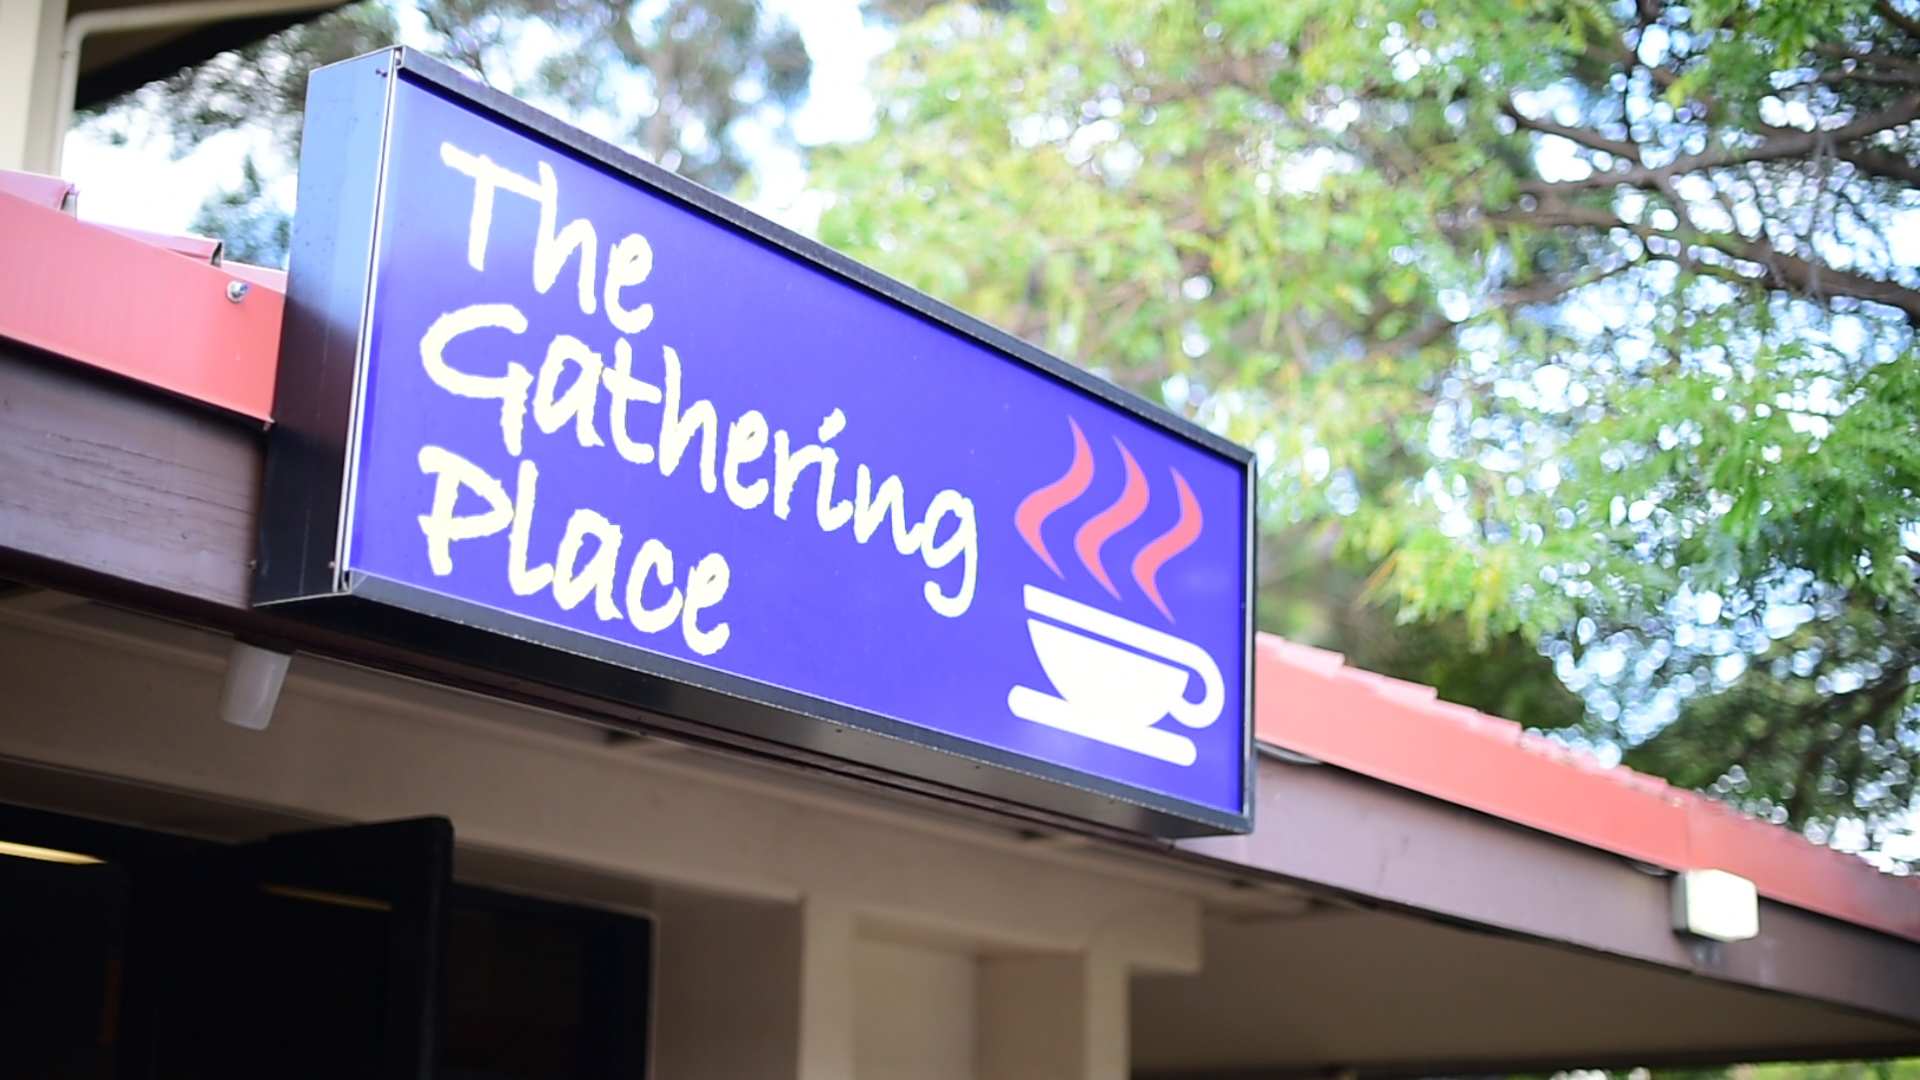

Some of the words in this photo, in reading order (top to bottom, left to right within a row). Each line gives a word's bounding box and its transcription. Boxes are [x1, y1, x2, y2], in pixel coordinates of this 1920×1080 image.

[439, 140, 655, 335] The
[417, 444, 731, 657] Place
[419, 302, 979, 618] Gathering
